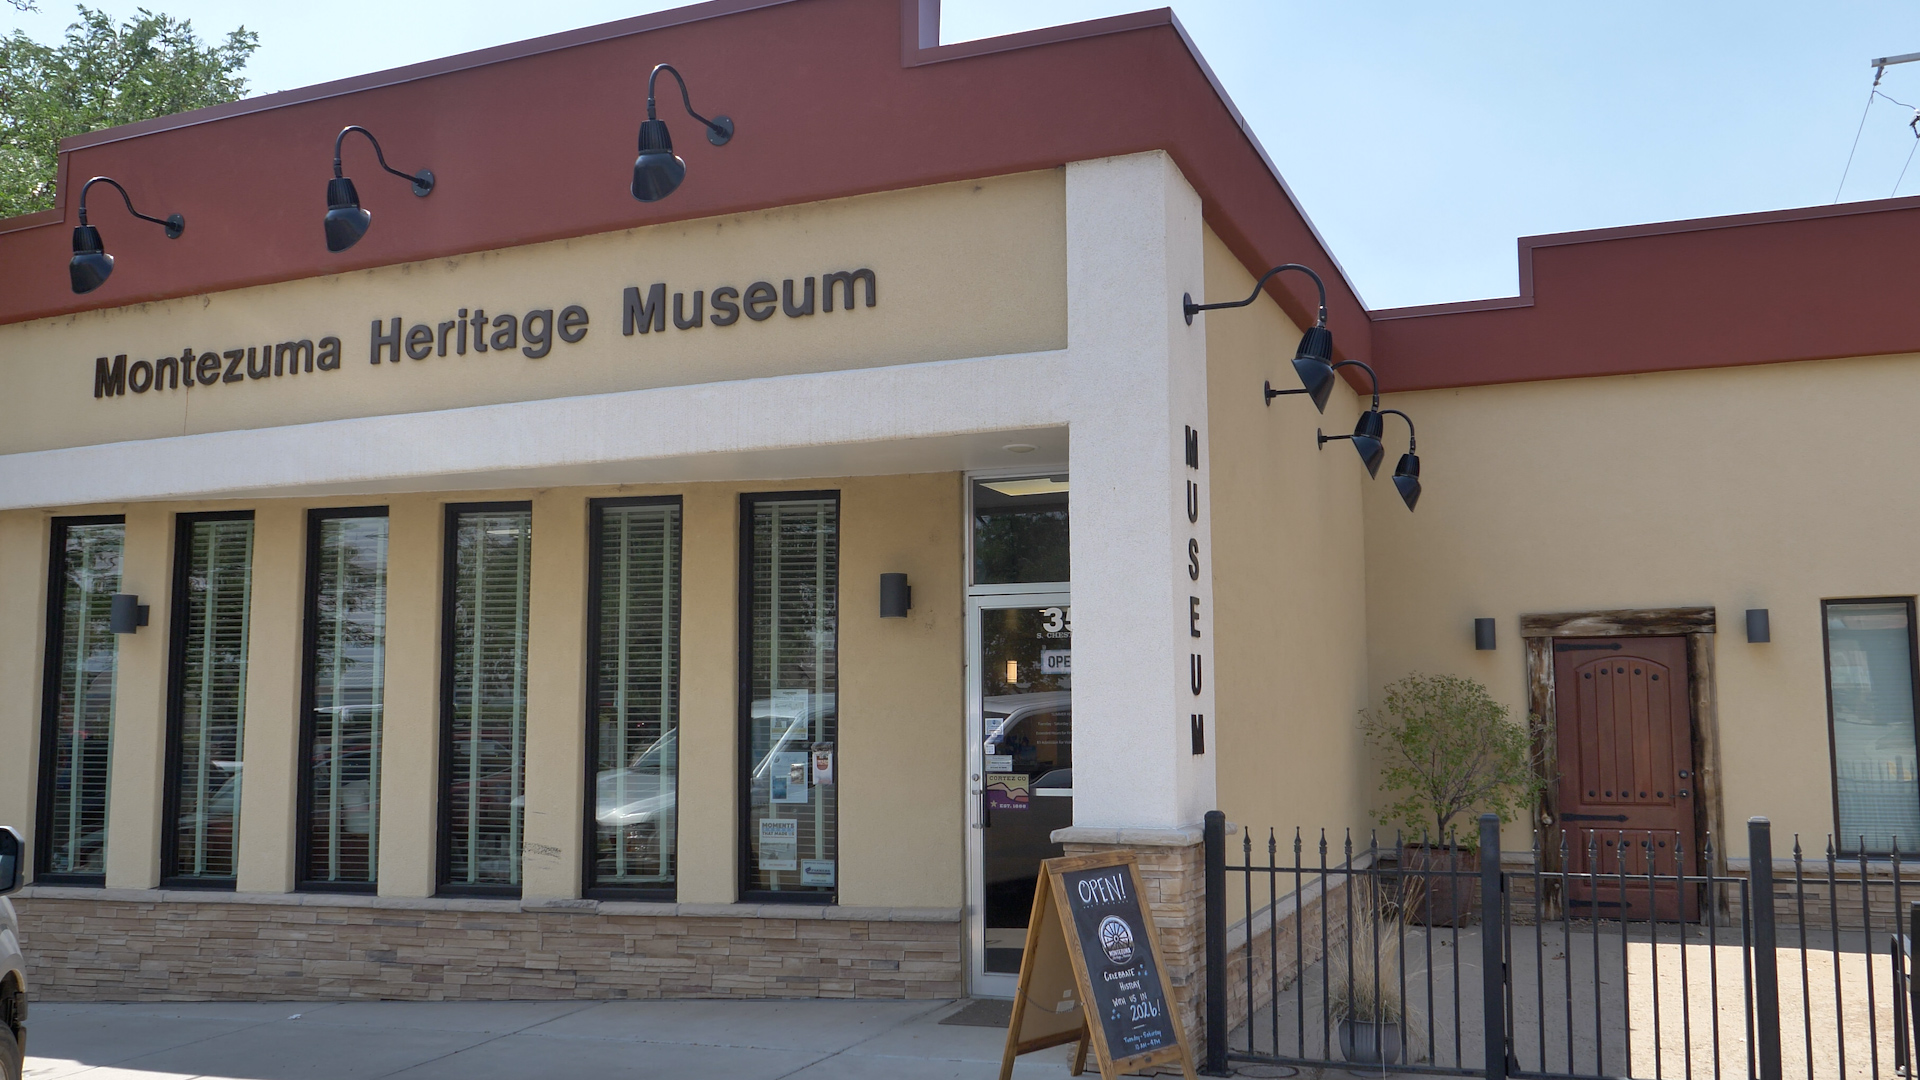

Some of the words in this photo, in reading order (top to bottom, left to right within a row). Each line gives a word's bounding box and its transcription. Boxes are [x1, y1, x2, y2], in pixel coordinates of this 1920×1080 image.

[93, 334, 341, 399] Montezuma
[369, 304, 590, 360] Heritage
[621, 267, 877, 336] Museum
[1184, 424, 1205, 756] MUSEUM
[1048, 655, 1071, 668] OPE
[1078, 873, 1127, 903] OPEN!
[1129, 993, 1138, 1003] US
[1139, 991, 1148, 1001] IN
[1130, 999, 1161, 1022] 2026!
